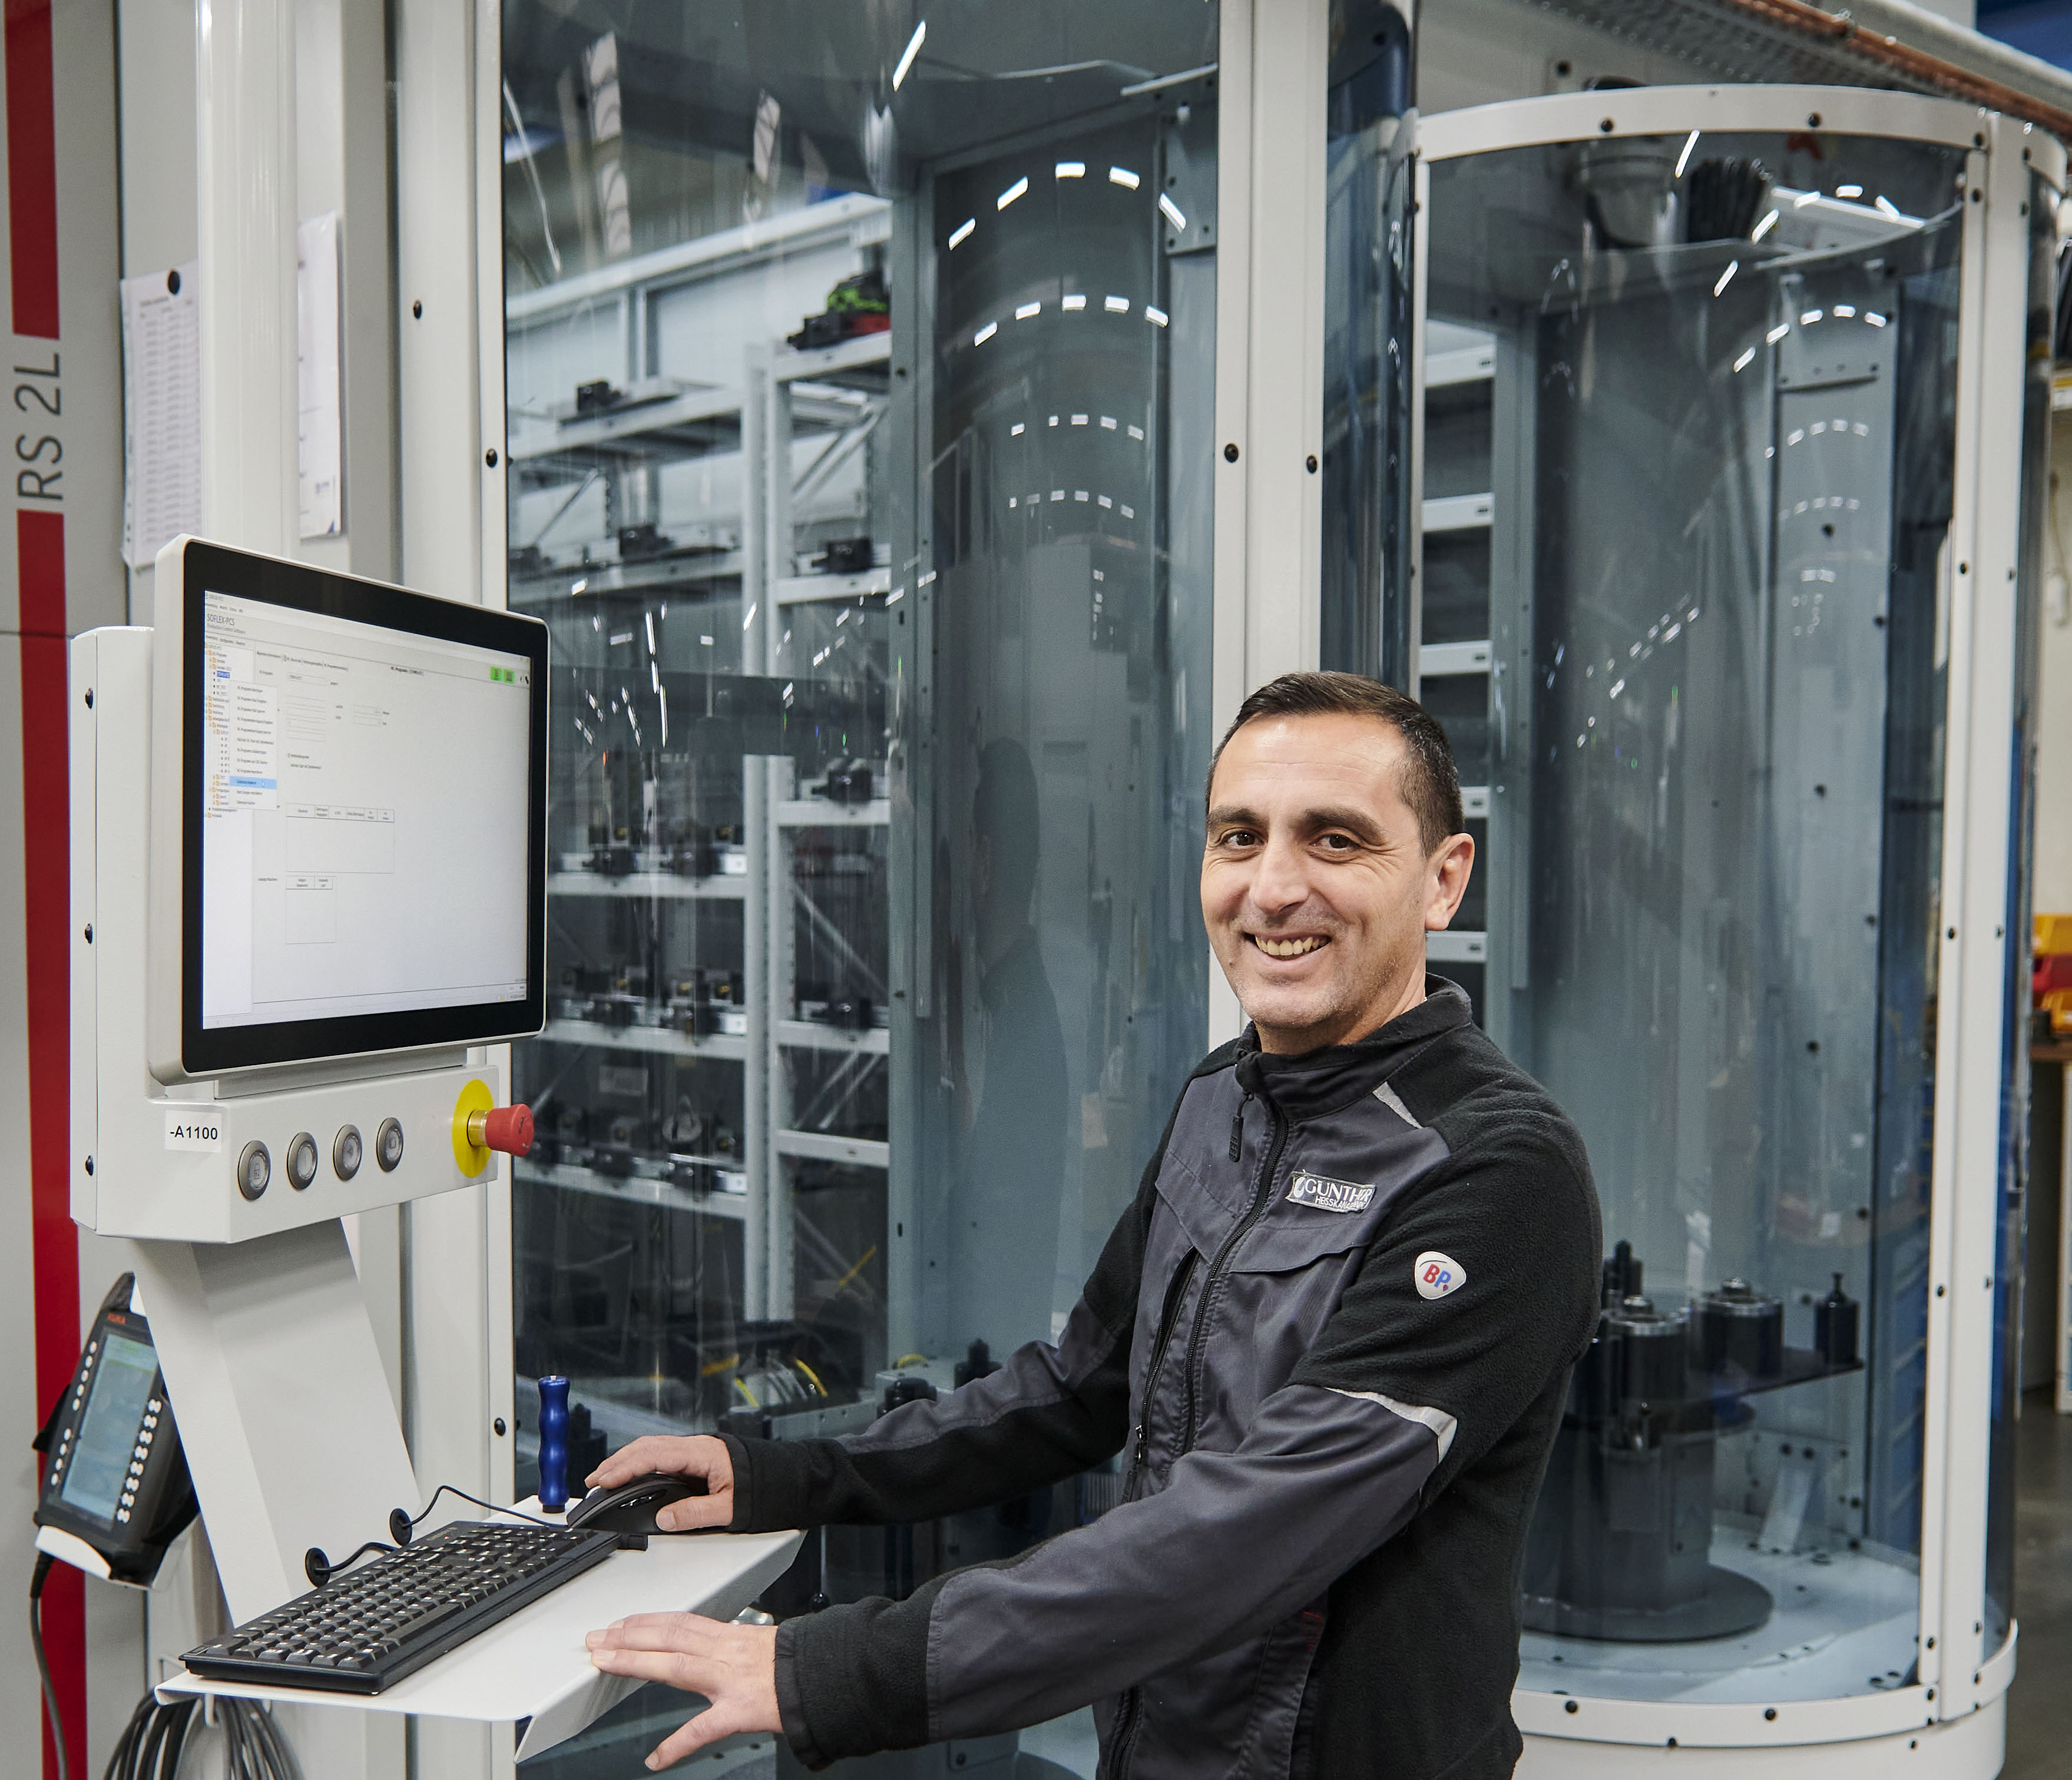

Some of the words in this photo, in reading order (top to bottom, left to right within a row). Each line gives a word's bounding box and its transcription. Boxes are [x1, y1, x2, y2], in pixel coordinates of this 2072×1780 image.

[13, 353, 61, 416] 2L
[15, 433, 64, 500] RS
[207, 613, 236, 626] SOFLEX-PCS
[170, 1125, 218, 1140] -A1100
